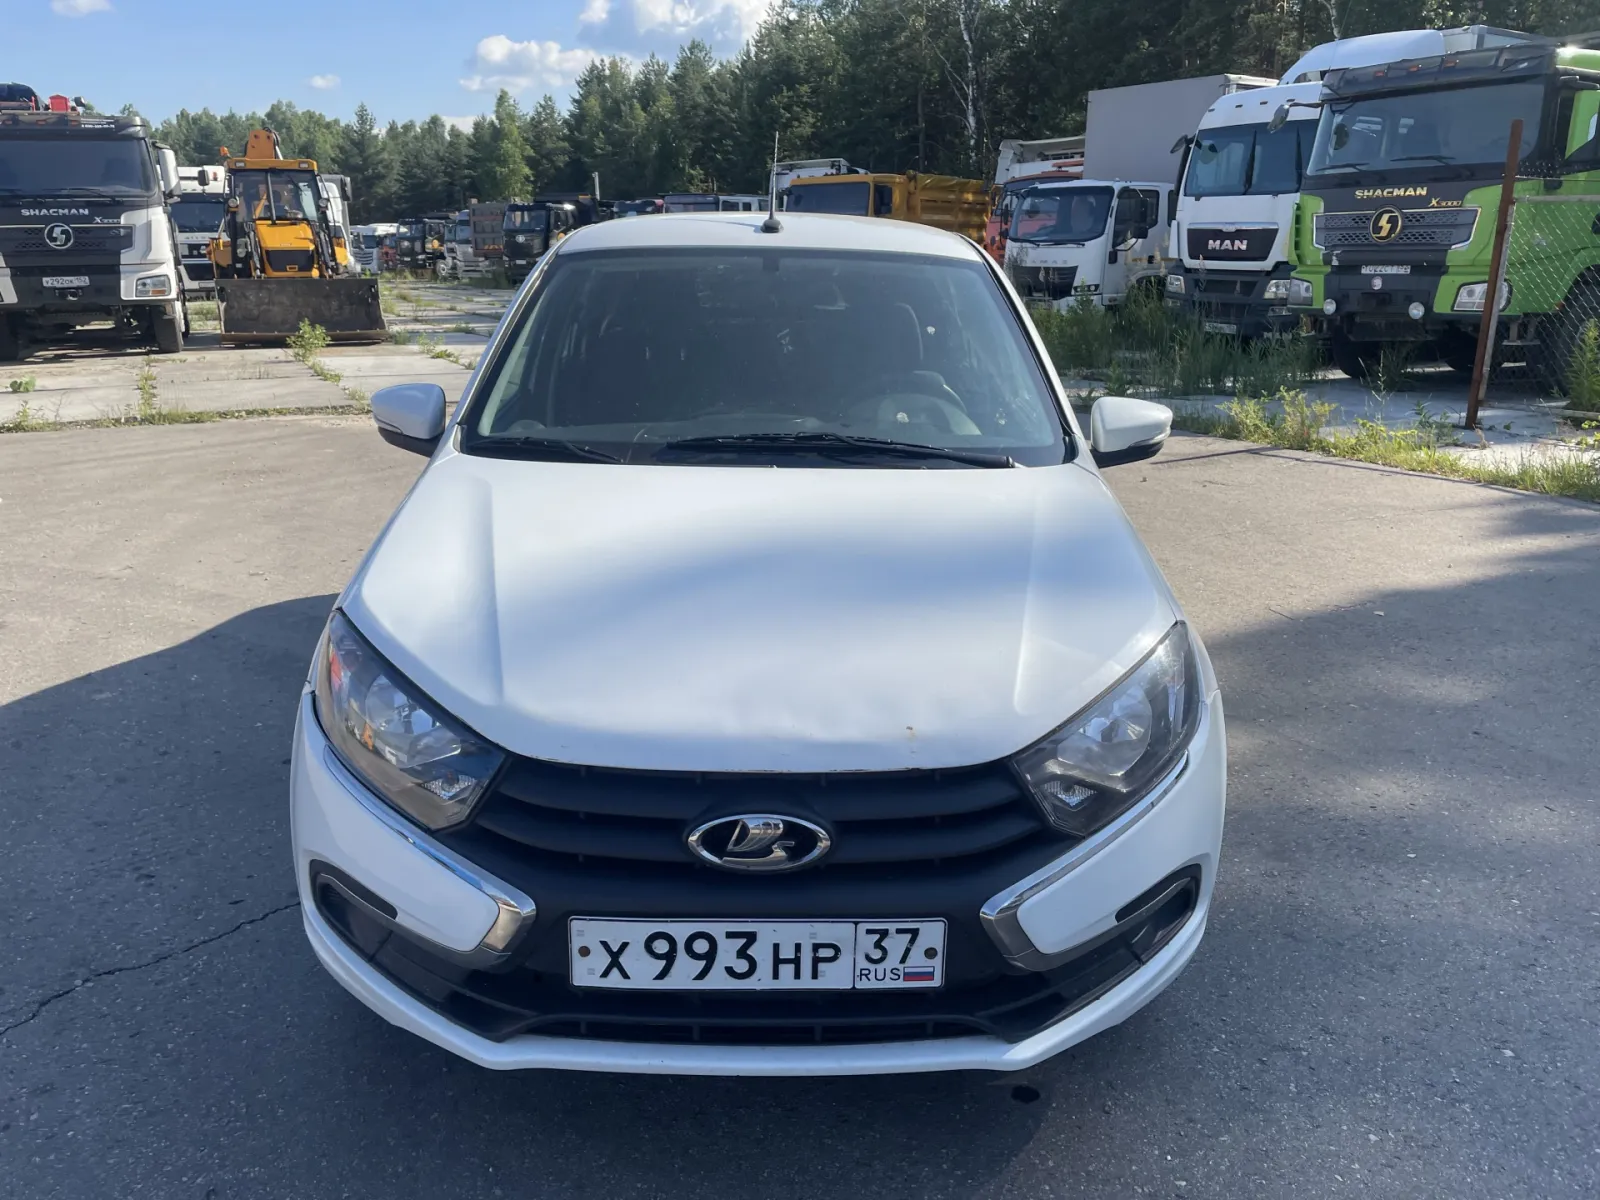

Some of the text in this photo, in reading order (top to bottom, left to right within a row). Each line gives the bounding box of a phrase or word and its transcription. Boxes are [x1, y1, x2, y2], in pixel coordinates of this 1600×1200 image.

[1355, 187, 1428, 199] SHACMAN
[20, 208, 90, 216] SHACMAN
[1207, 239, 1248, 251] MAN
[864, 927, 920, 965] 37
[859, 967, 901, 982] RUS
